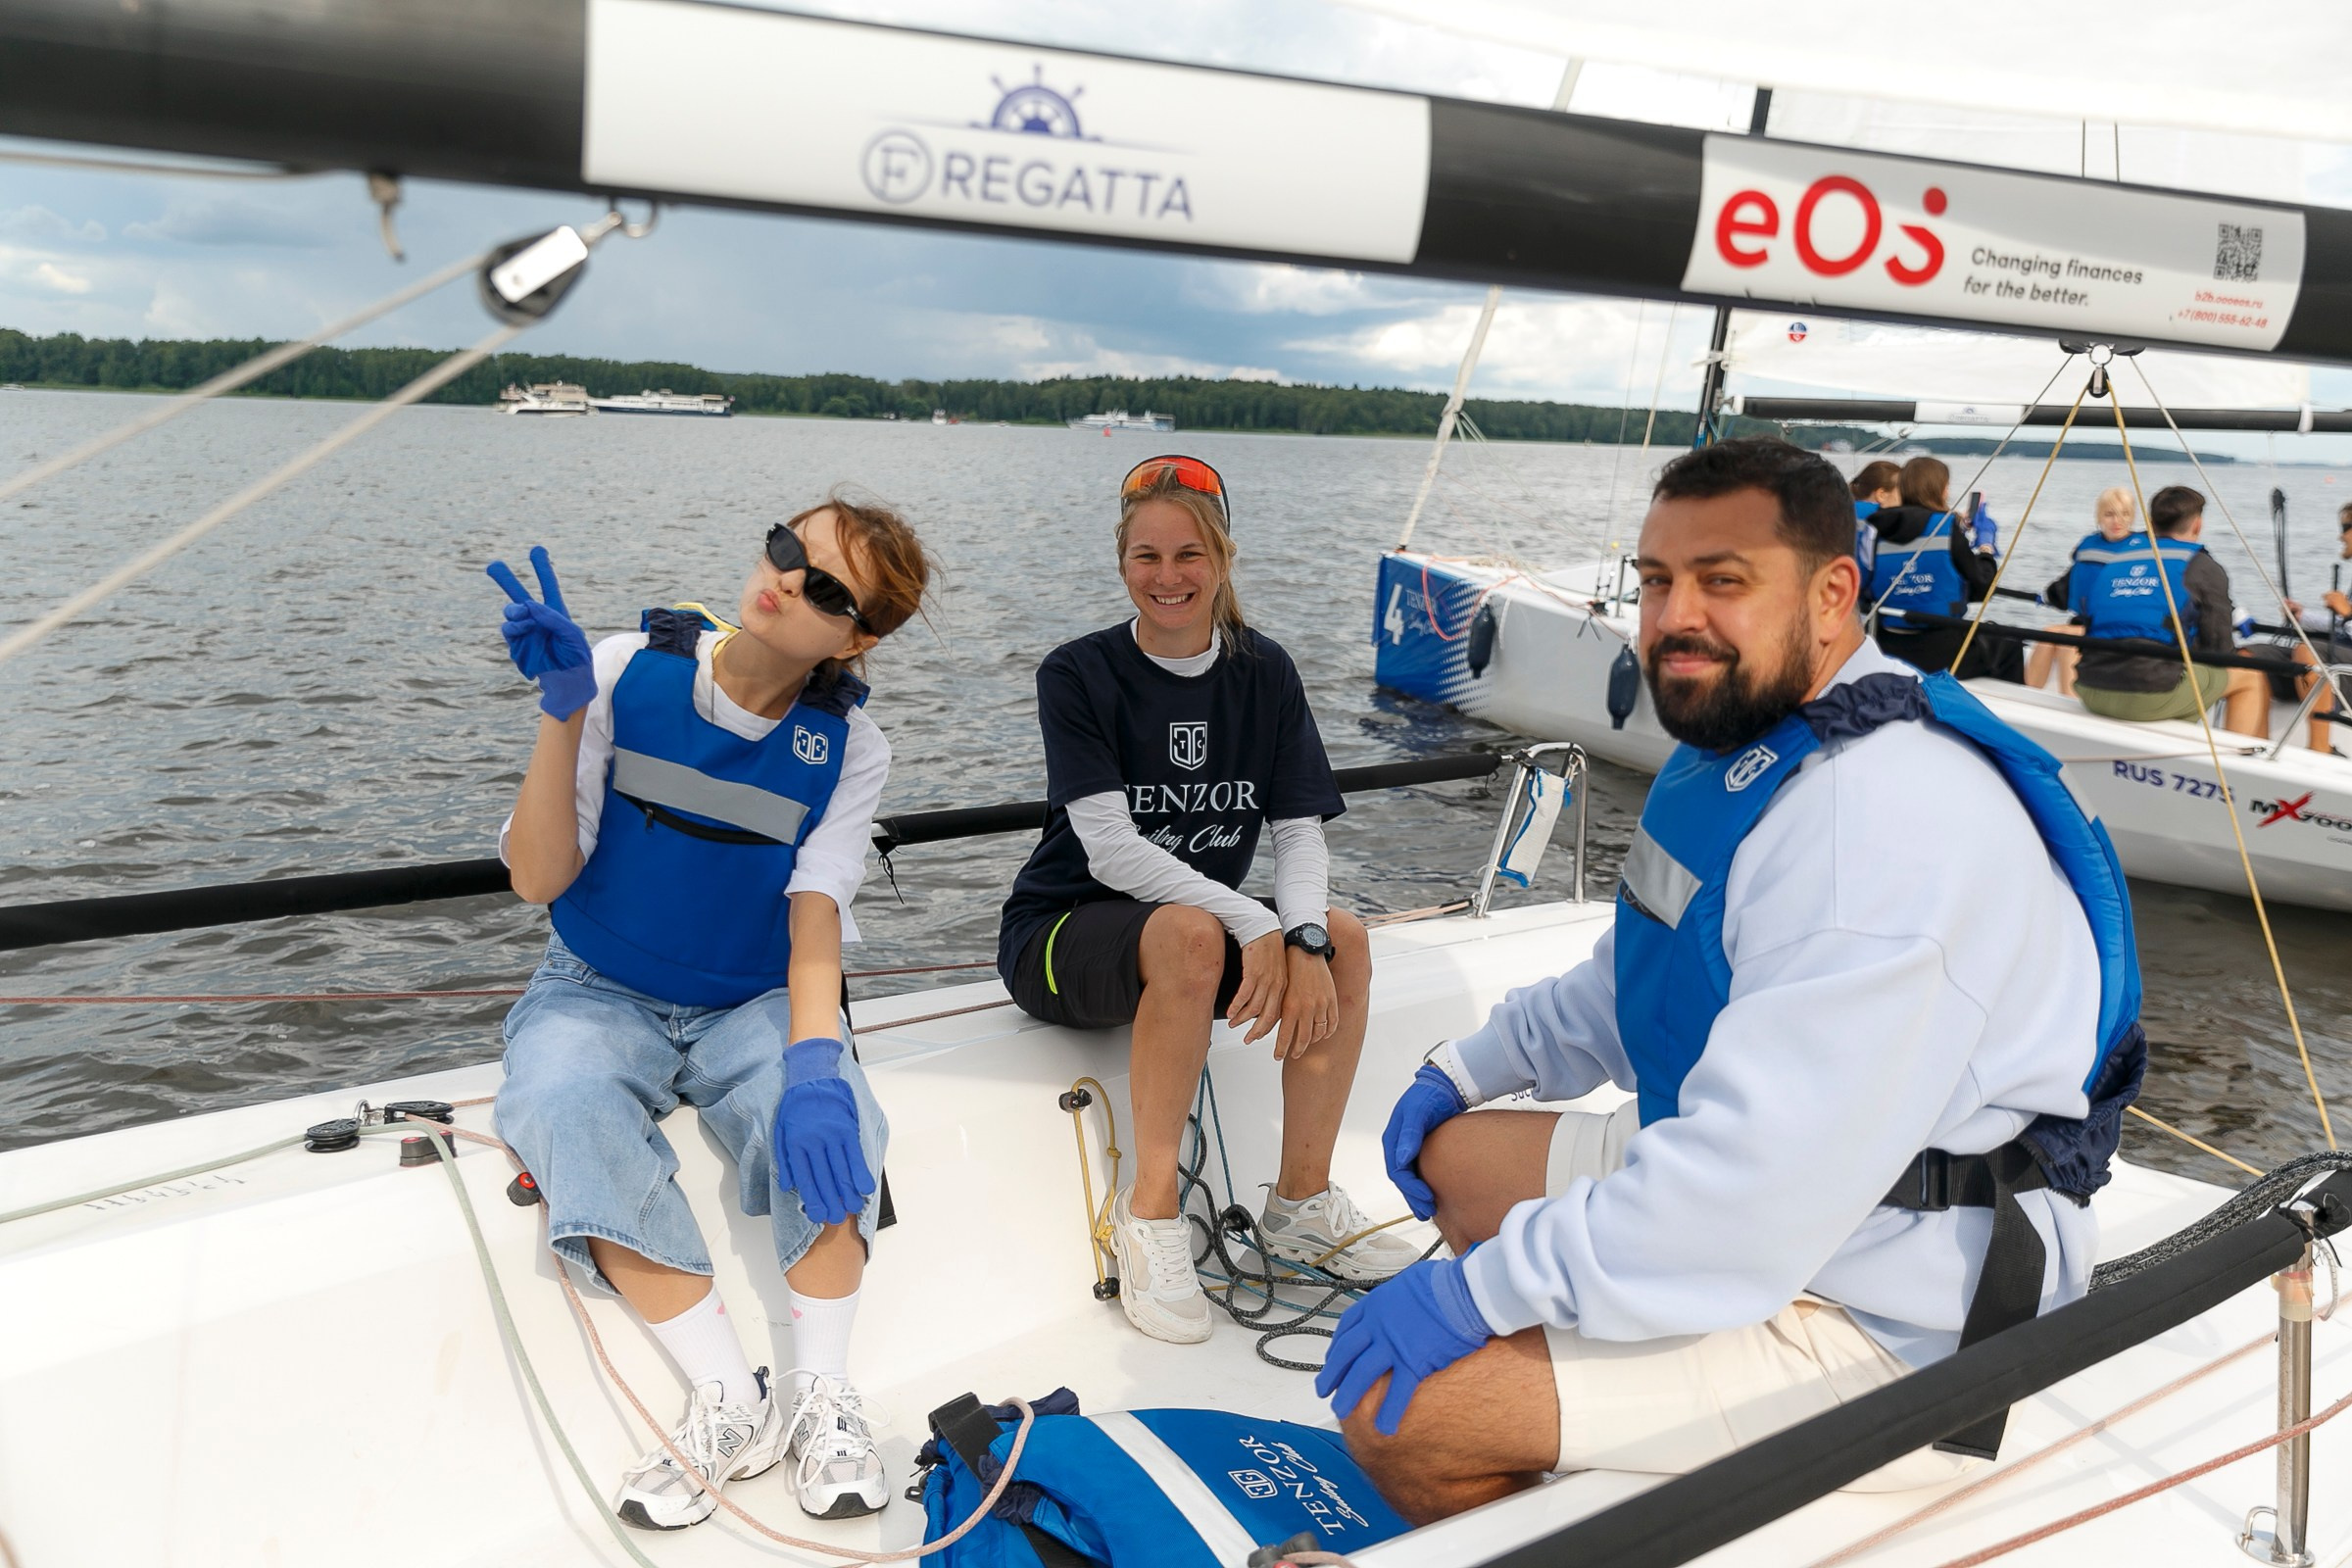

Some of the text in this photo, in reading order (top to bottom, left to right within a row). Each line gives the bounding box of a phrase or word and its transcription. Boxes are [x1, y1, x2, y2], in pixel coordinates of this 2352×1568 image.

[941, 151, 1195, 221] REGATTA
[1971, 247, 2142, 284] Changing finances
[1964, 276, 2089, 307] for the better.
[1383, 581, 1405, 647] 4
[2113, 760, 2166, 788] RUS
[1124, 781, 1260, 813] ENZOR
[1189, 824, 1243, 854] Club
[1239, 1435, 1347, 1536] TENZOR
